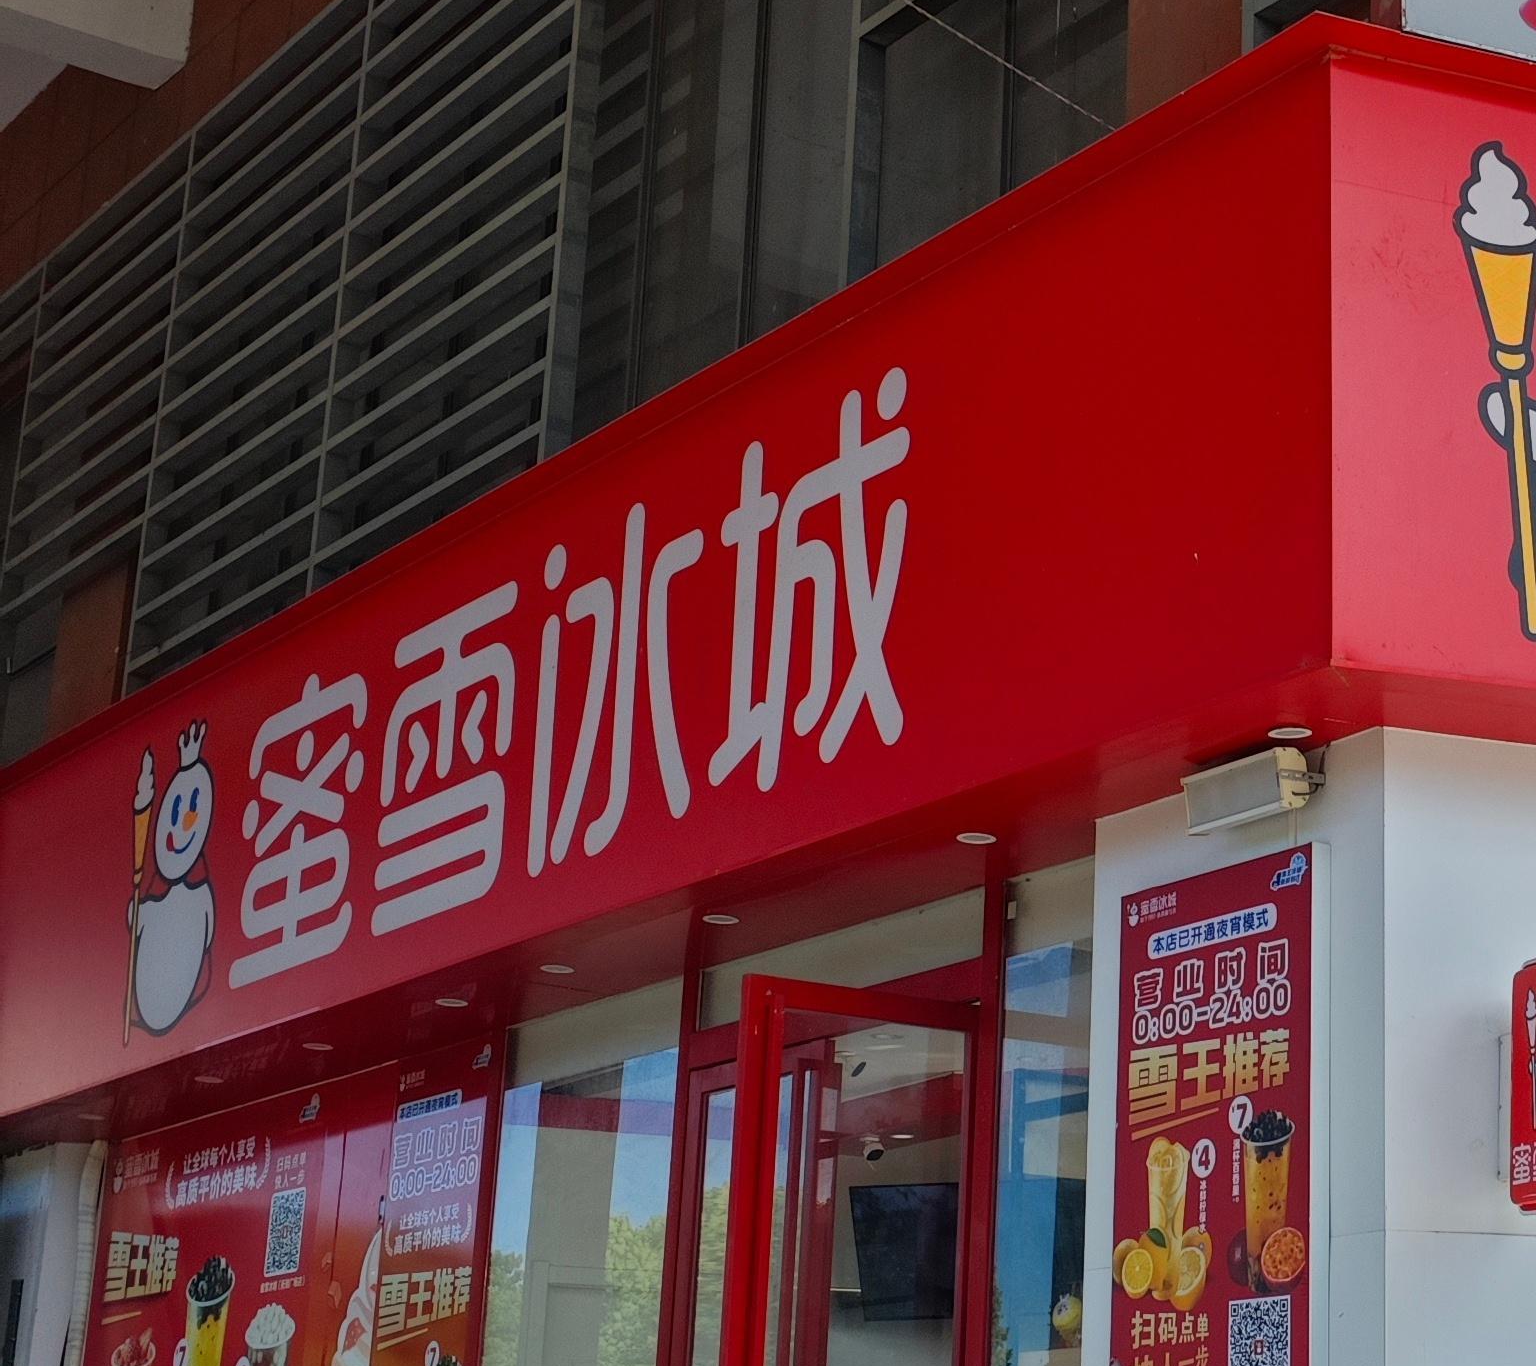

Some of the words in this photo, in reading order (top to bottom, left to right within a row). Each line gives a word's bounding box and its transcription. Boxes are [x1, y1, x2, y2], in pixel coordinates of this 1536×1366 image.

[228, 367, 911, 990] 蜜雪冰城
[1152, 908, 1269, 955] 本店已开通夜宵模式
[1134, 939, 1289, 1012] 营业时间
[1128, 1028, 1290, 1126] 雪王推荐
[175, 1162, 258, 1208] 高质平价的美味
[183, 1135, 257, 1176] 让全球每个人享受
[103, 1230, 180, 1302] 雪王推荐
[376, 1265, 473, 1338] 雪王推荐
[1130, 1310, 1210, 1350] 扫码点单
